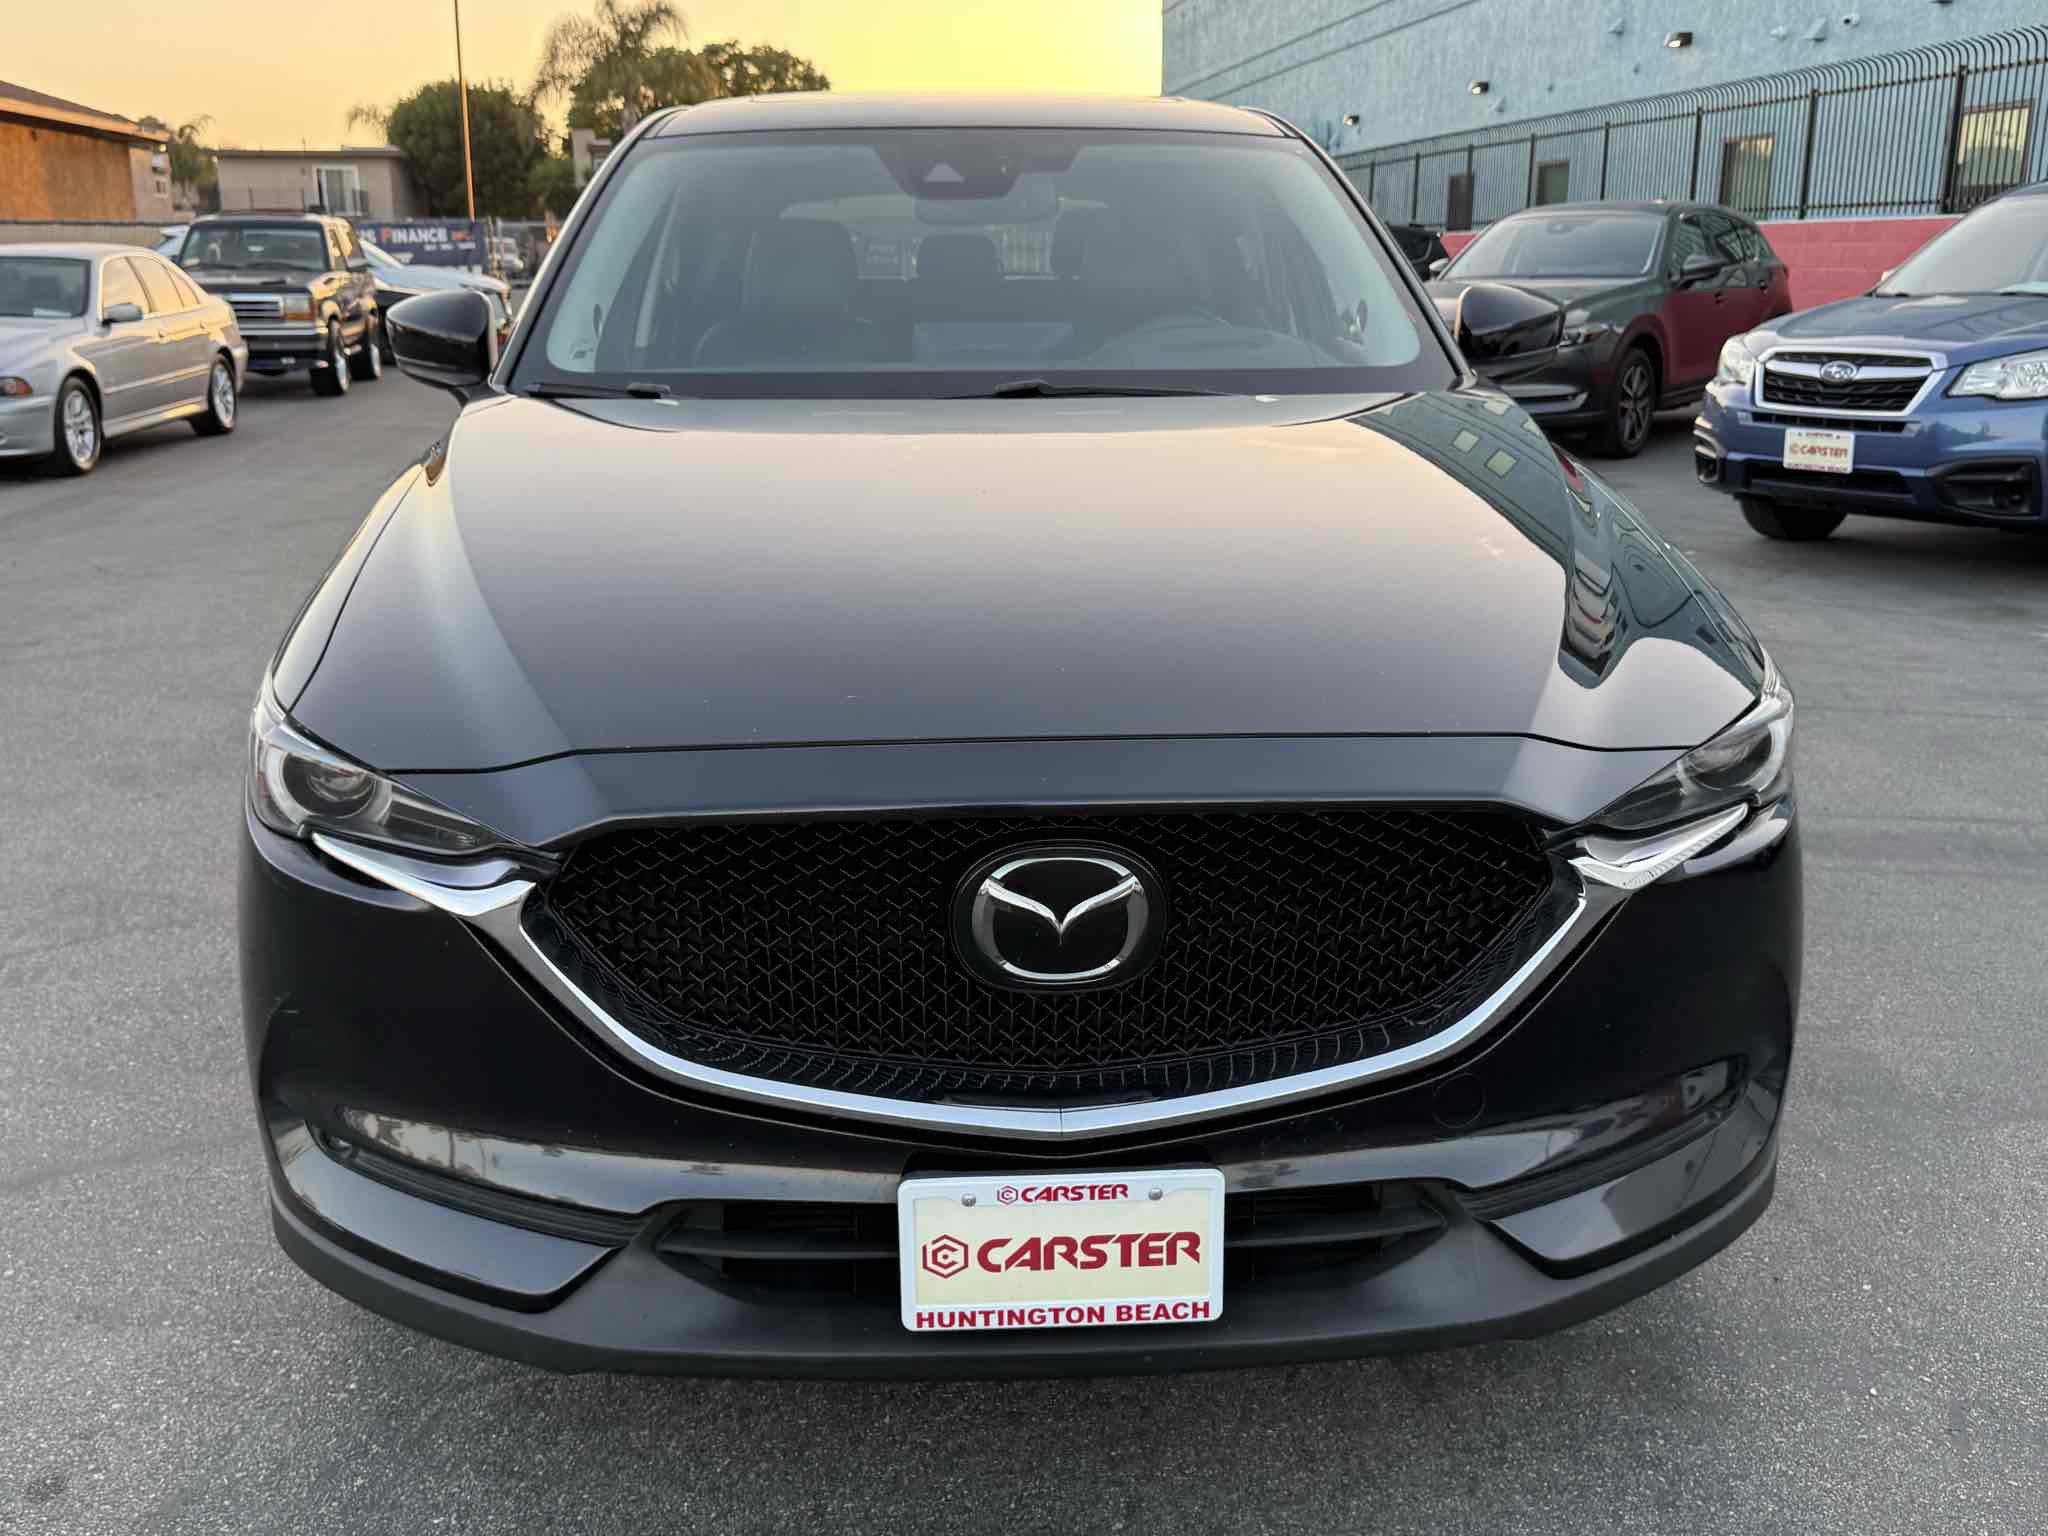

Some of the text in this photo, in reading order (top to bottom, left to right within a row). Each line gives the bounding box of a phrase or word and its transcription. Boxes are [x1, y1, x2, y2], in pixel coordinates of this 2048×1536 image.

[380, 226, 447, 244] FINANCE
[1021, 1183, 1129, 1203] CARSTER
[976, 1231, 1201, 1273] CARSTER
[915, 1301, 1210, 1329] HUNTINGTON BEACH
